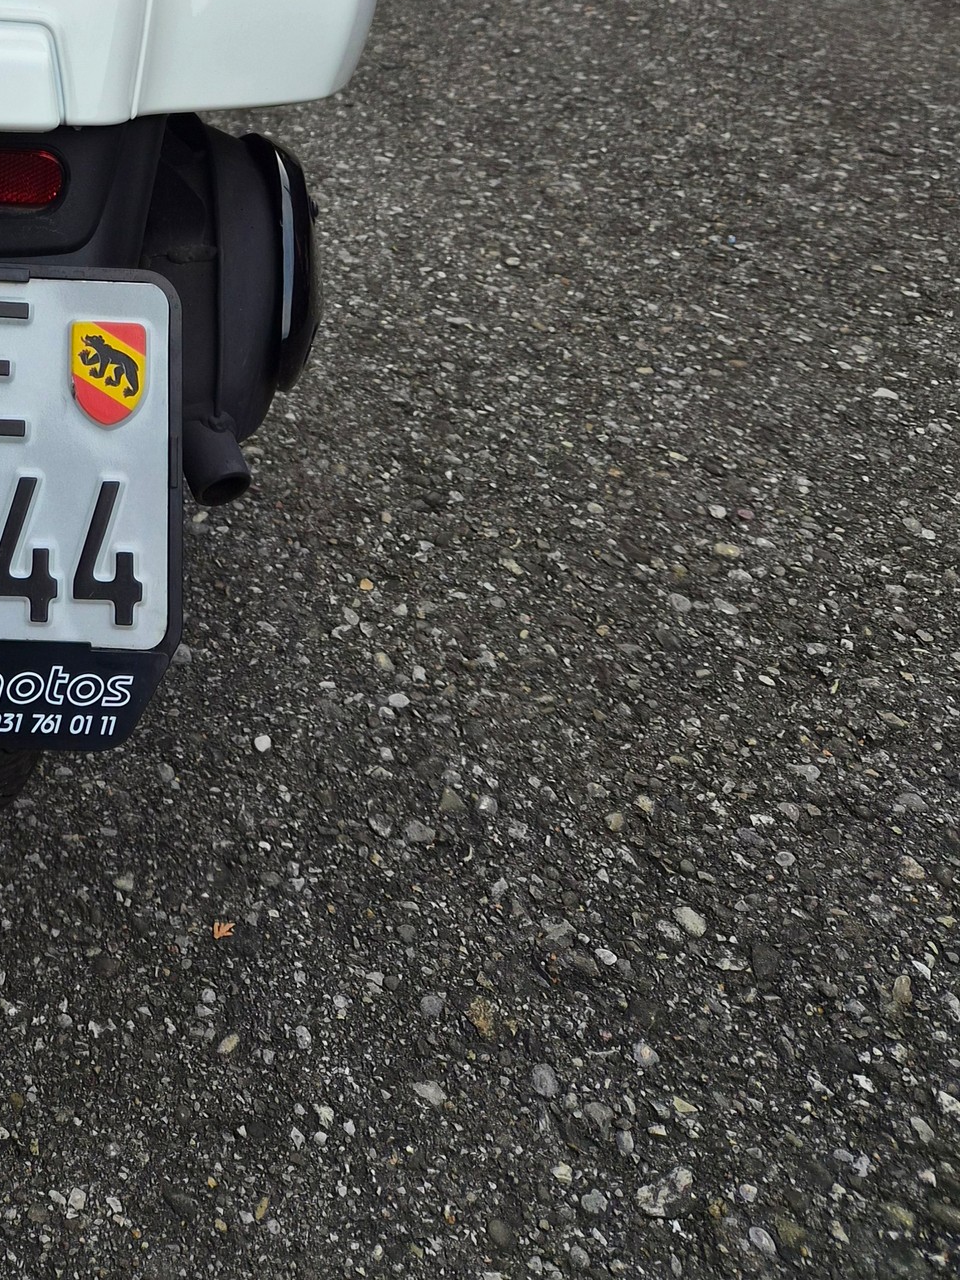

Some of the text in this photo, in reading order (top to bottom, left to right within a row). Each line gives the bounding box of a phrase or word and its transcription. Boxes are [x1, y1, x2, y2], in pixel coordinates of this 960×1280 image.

[30, 713, 62, 734] 761
[70, 715, 94, 735] 01
[100, 715, 117, 736] 11
